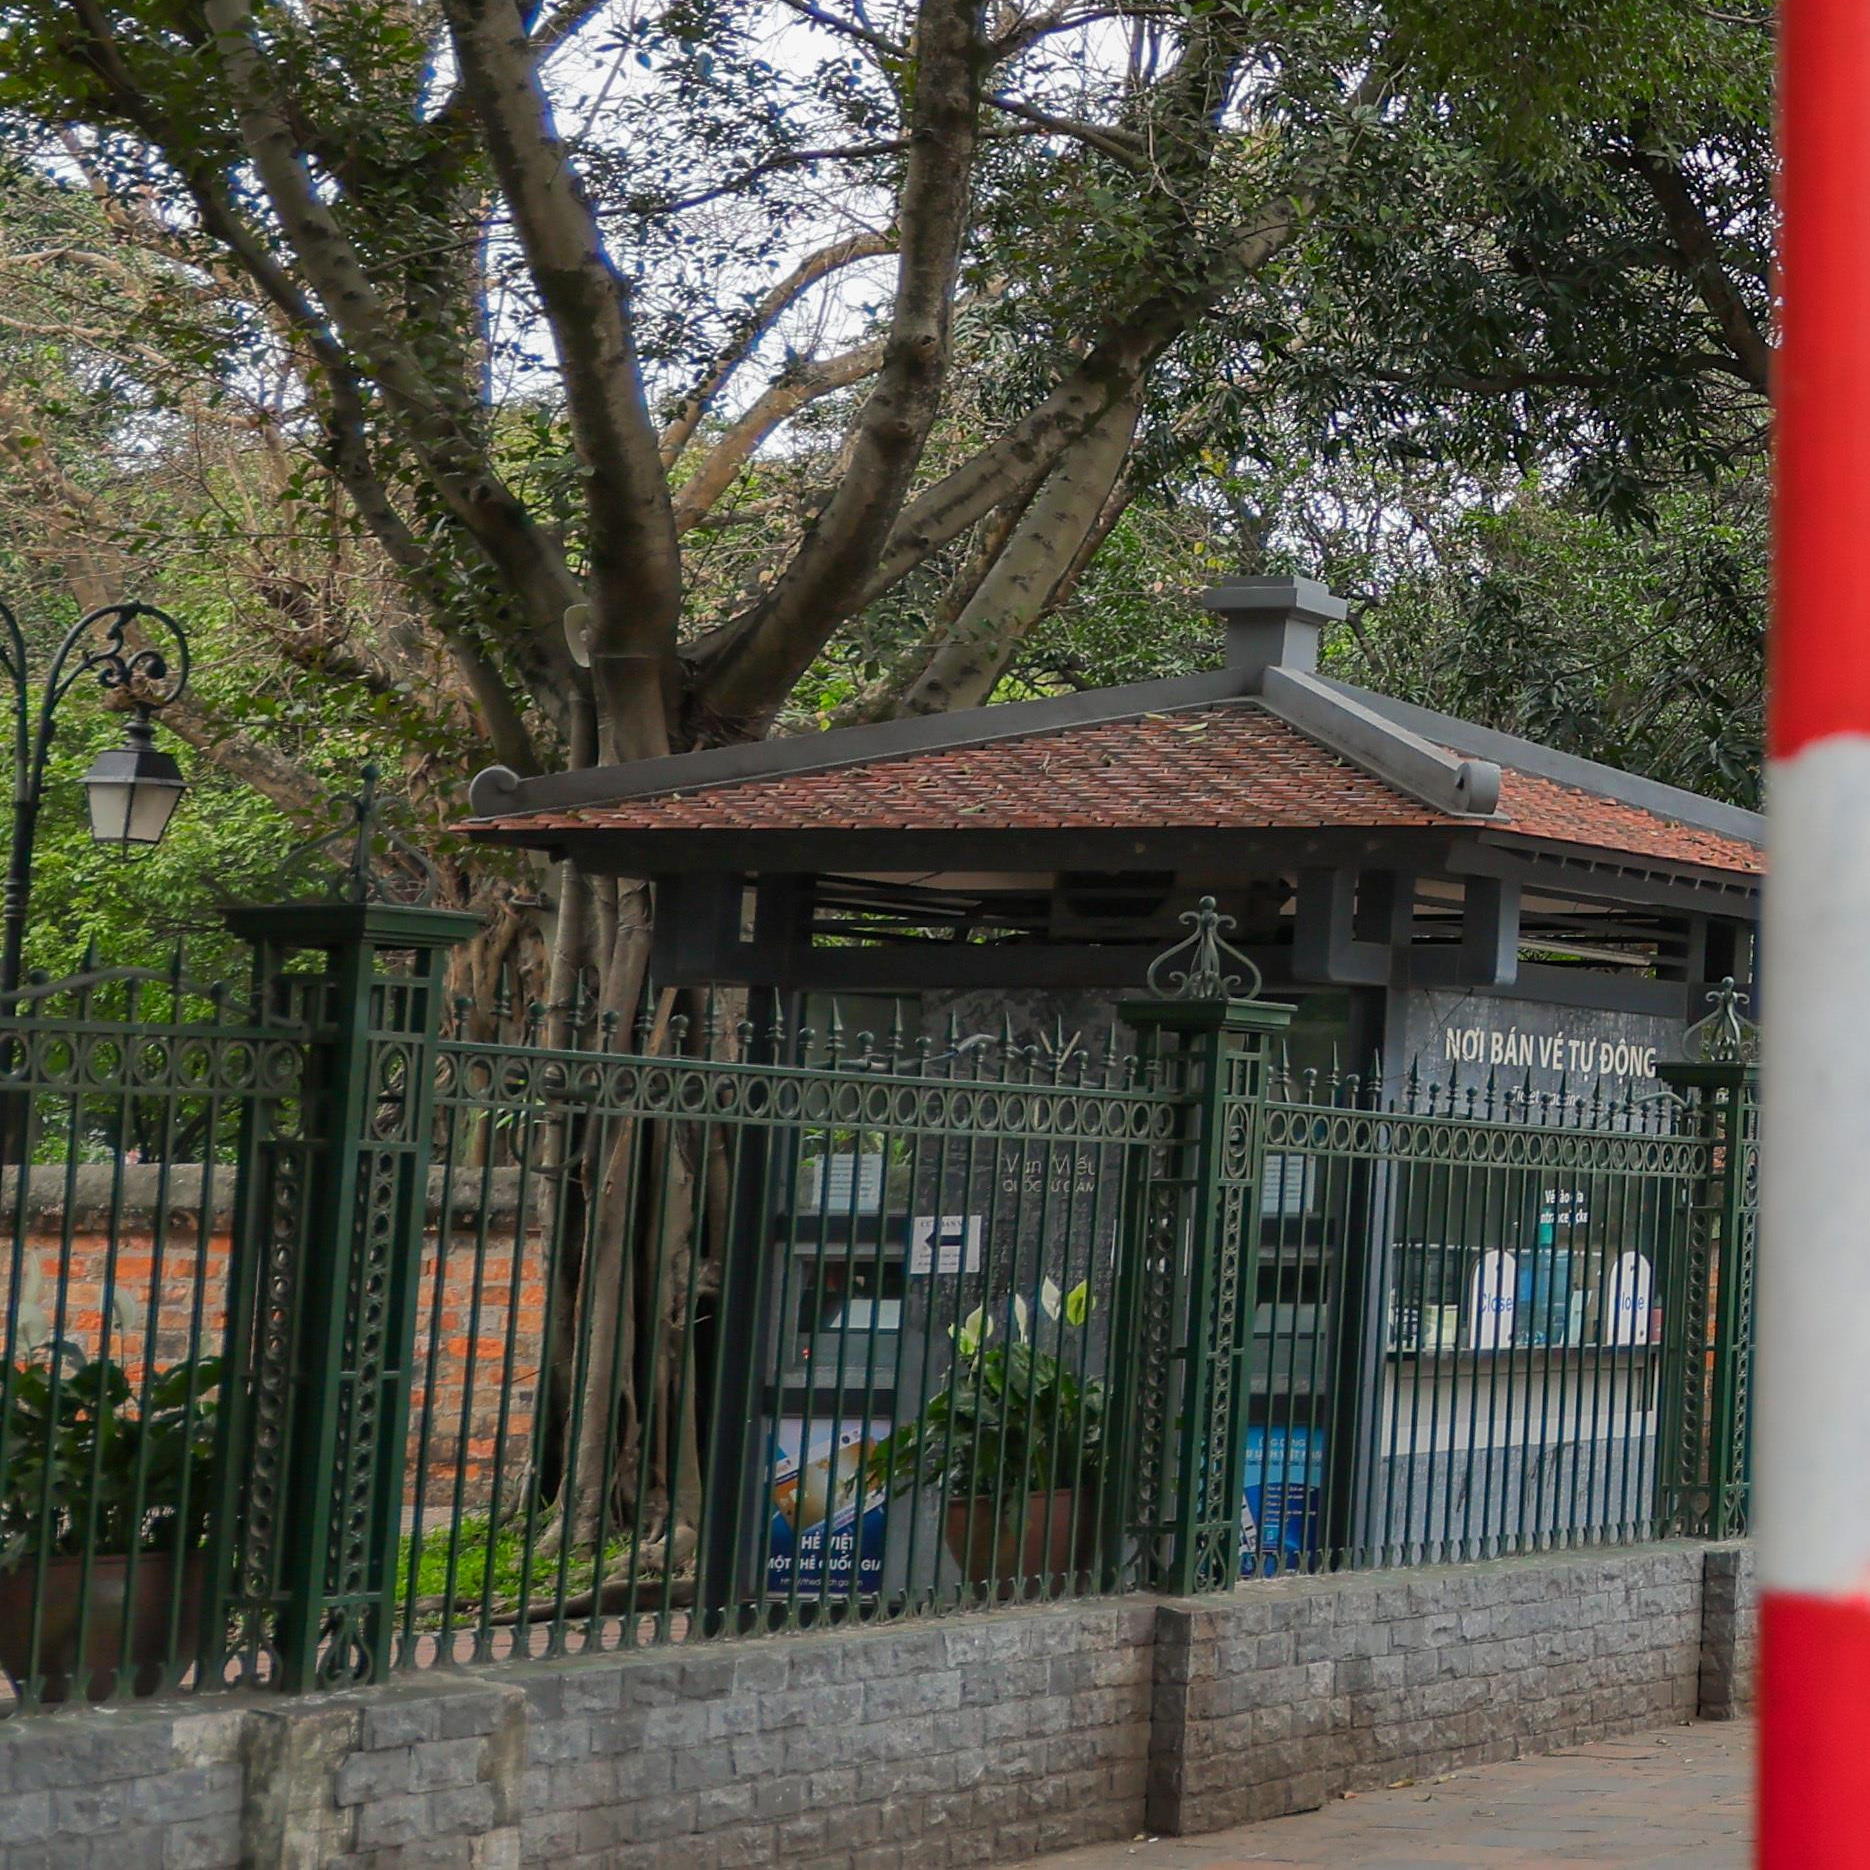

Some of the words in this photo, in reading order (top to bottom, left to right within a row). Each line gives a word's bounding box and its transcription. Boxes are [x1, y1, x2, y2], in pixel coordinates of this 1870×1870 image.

[1445, 1026, 1485, 1063] NƠI
[1490, 1026, 1534, 1066] BÁN
[1539, 1032, 1564, 1070] VÉ
[1568, 1037, 1597, 1082] TỰ
[1600, 1038, 1656, 1084] ĐỘNG
